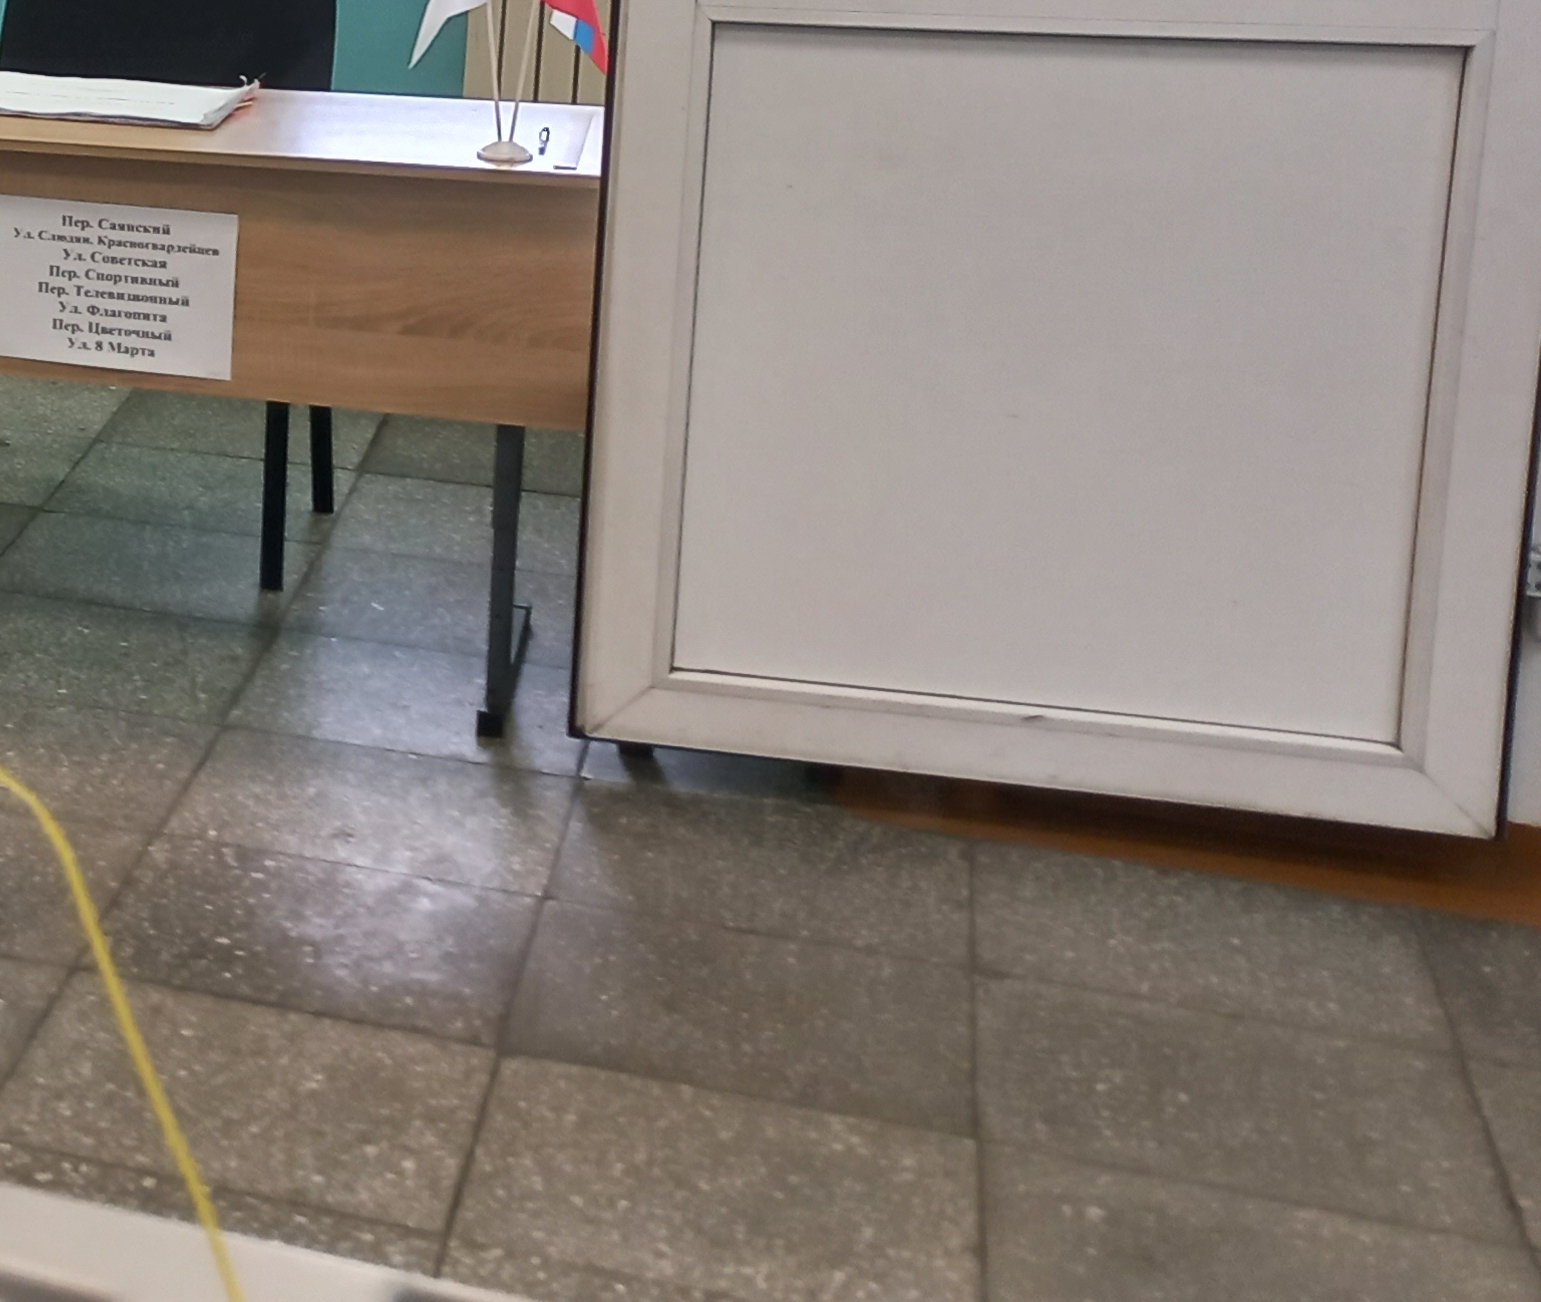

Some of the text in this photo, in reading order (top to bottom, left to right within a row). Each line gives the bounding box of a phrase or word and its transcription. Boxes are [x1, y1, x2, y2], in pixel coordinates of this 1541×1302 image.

[62, 214, 171, 235] Пер. Саянский
[13, 227, 35, 239] Ул.
[97, 235, 220, 256] Красногвардейцев
[62, 248, 167, 269] Ул. Советская
[49, 264, 179, 288] Пер. Спортивный
[38, 281, 69, 298] Пер.
[58, 301, 82, 314] Ул.
[52, 318, 172, 342] Пер. Цветочный
[67, 337, 156, 358] Ул. 8 Марта
